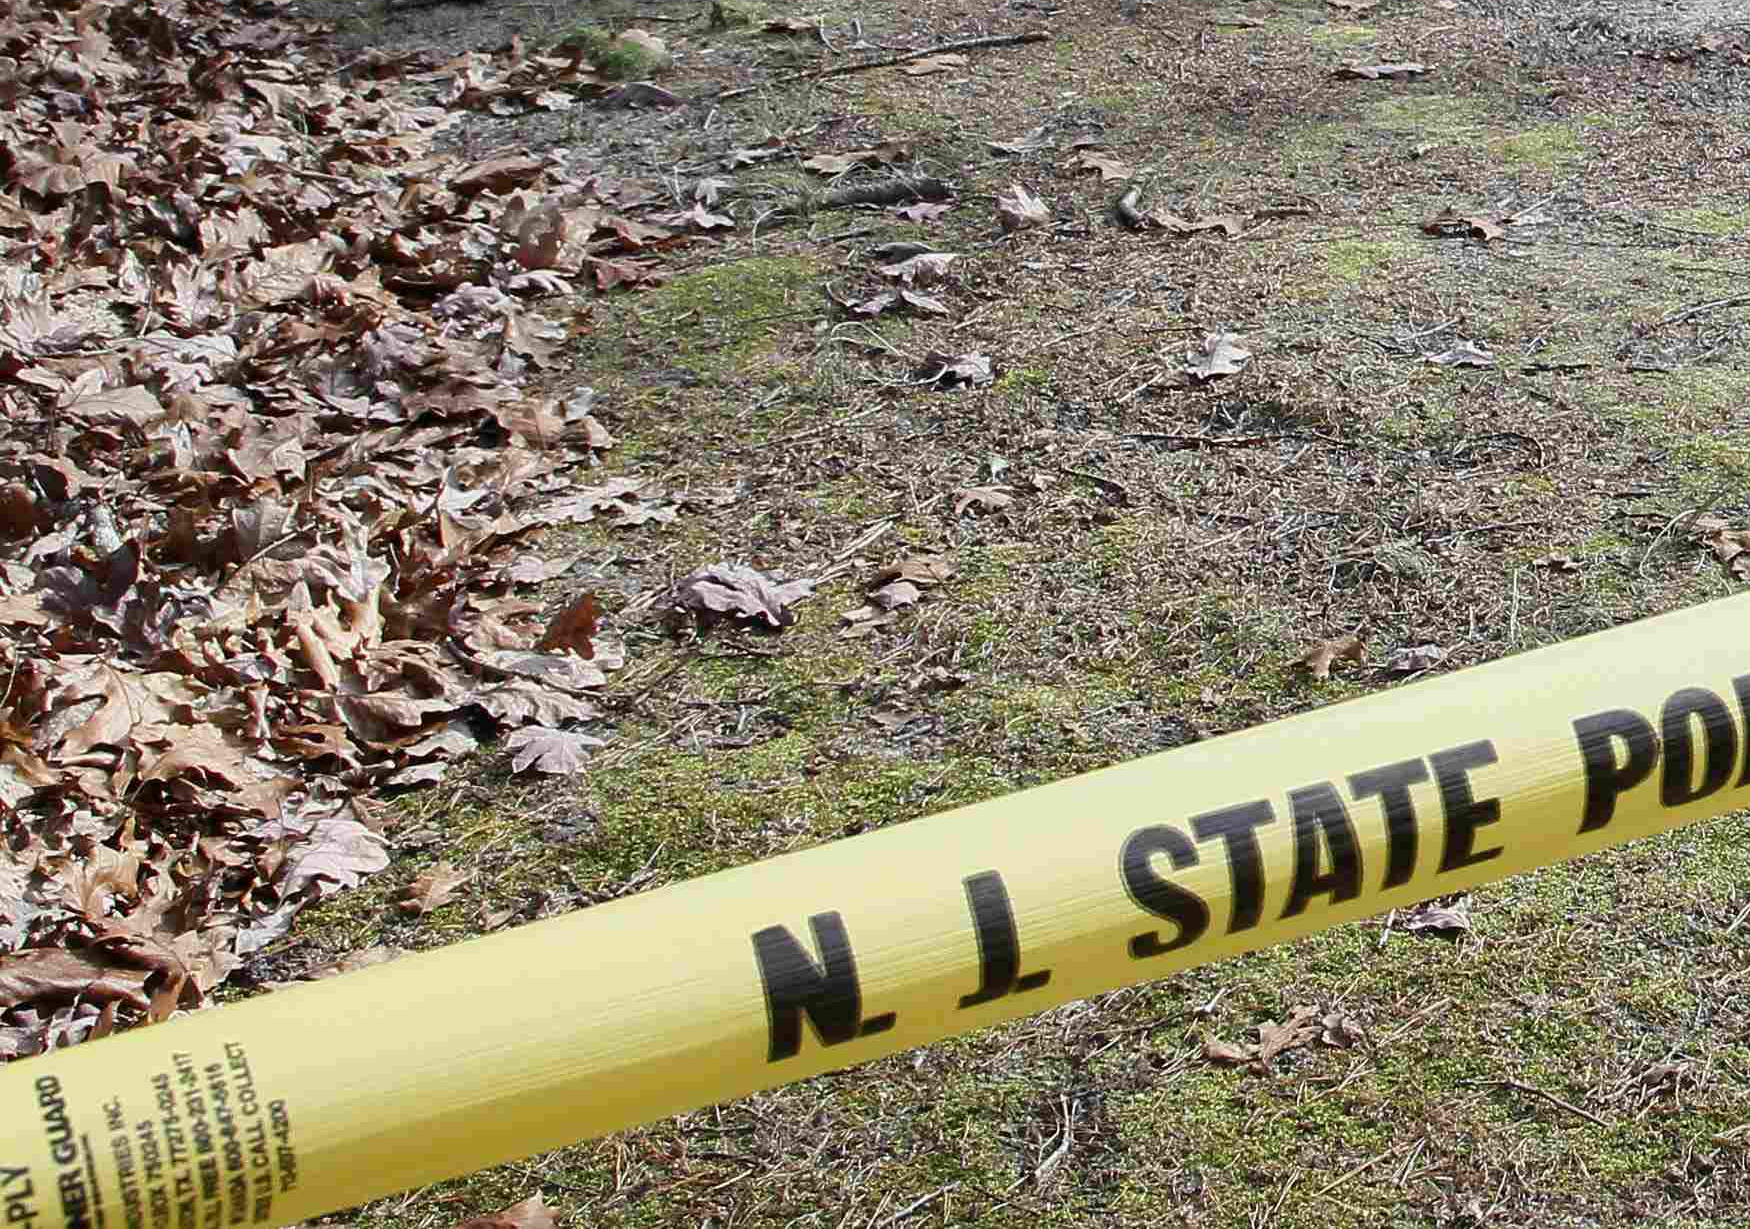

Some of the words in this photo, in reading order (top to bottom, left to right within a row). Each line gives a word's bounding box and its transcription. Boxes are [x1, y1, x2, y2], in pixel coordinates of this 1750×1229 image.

[1118, 739, 1504, 959] STATE
[34, 1074, 78, 1165] GUARD
[224, 1041, 260, 1117] COLLECT
